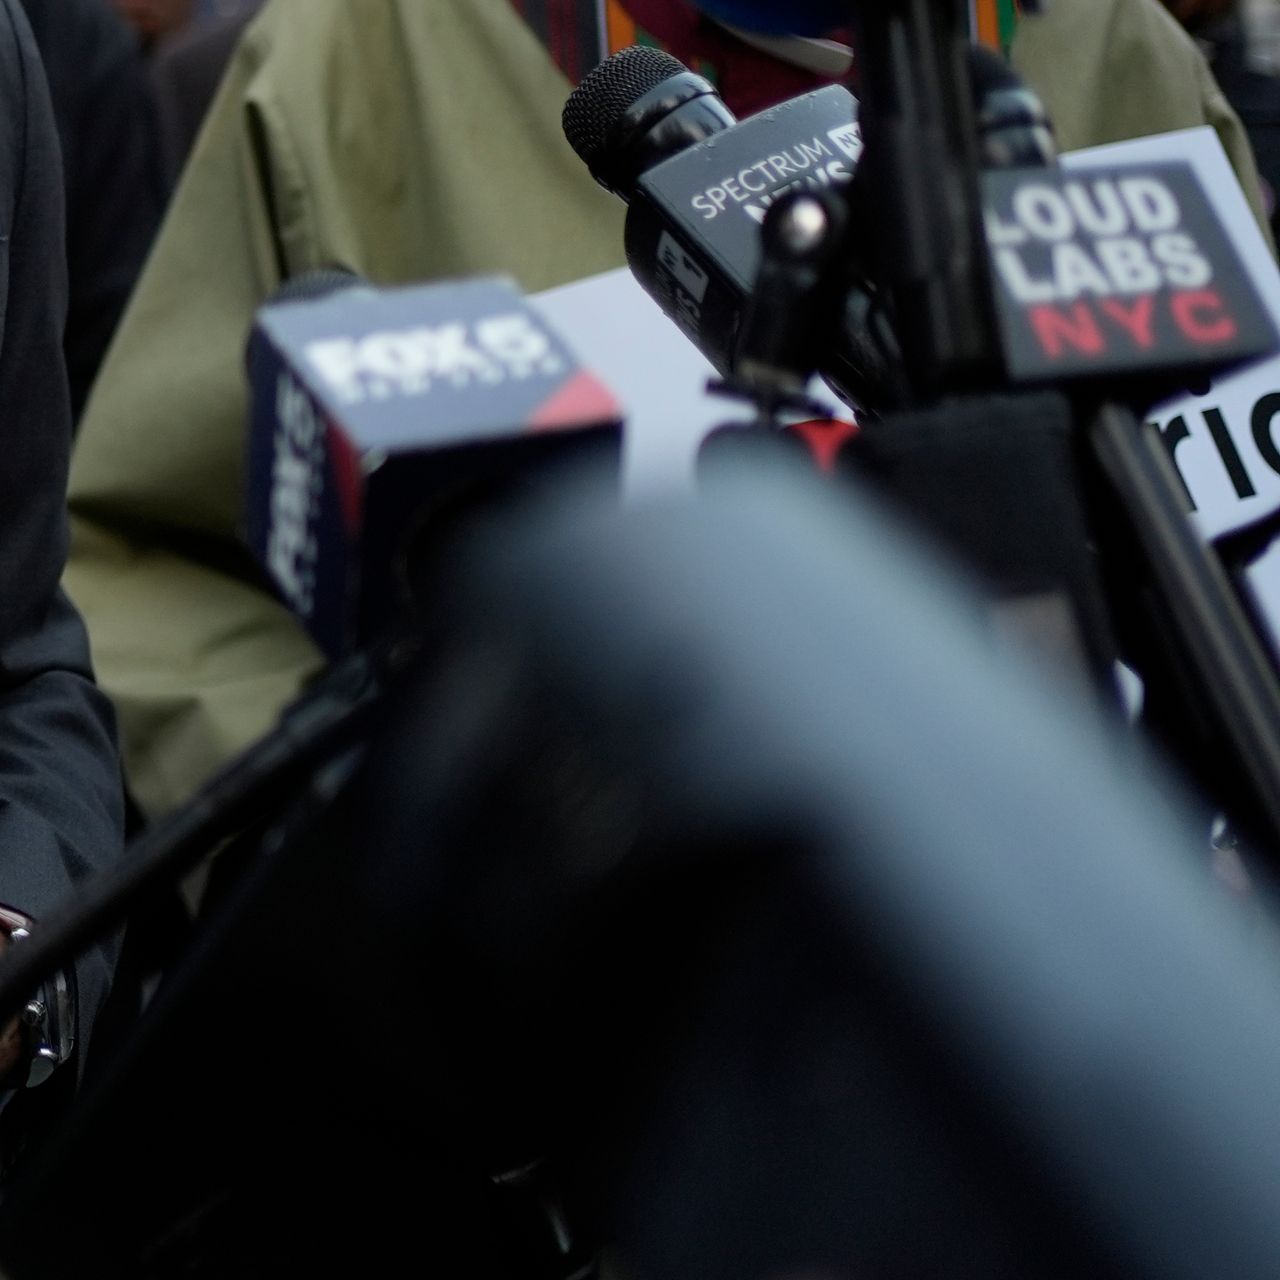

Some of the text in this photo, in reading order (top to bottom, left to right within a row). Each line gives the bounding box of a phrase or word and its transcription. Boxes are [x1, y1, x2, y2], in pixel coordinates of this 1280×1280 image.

[690, 137, 833, 220] SPECTRUM
[983, 177, 1182, 246] LOUD
[993, 233, 1214, 304] LABS
[1029, 286, 1239, 363] NYC
